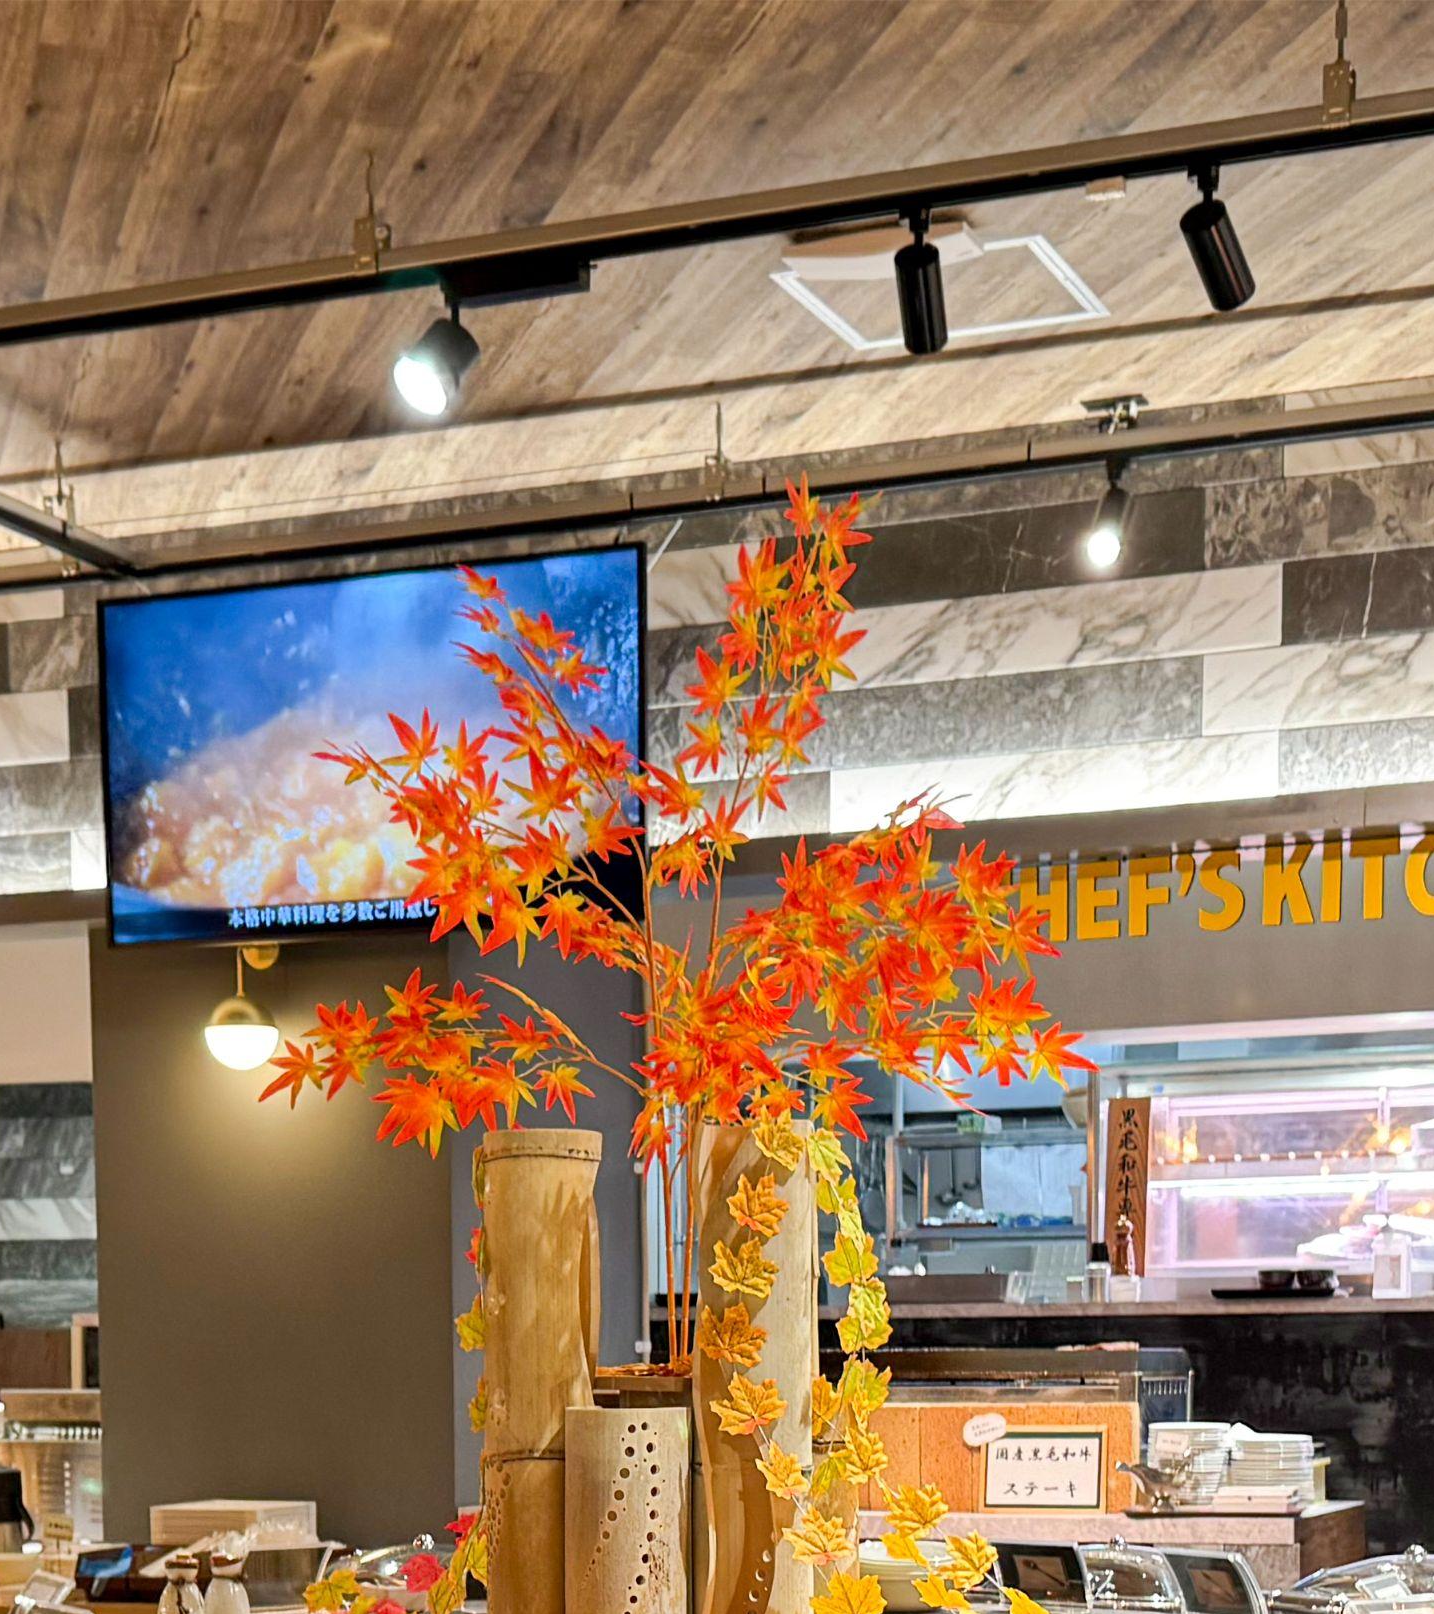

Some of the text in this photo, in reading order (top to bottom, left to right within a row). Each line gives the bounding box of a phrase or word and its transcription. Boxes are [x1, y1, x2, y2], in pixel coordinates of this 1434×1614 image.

[998, 850, 1246, 942] HEF'S
[995, 1446, 1092, 1463] 国産黒毛和牛
[1002, 1480, 1077, 1498] ステーキ
